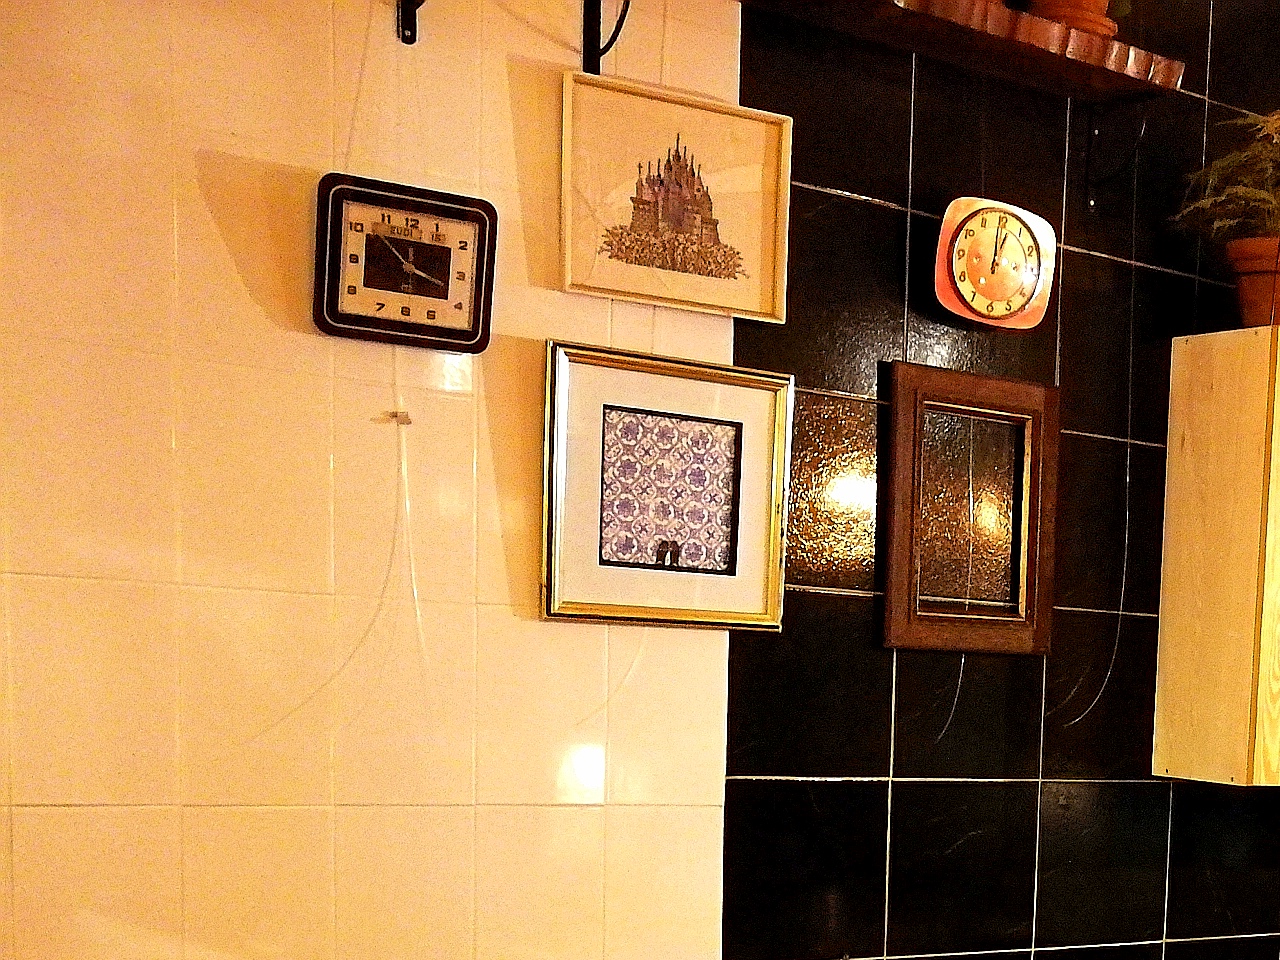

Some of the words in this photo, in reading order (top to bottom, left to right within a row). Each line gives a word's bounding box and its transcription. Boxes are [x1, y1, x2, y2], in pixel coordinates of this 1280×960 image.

[349, 222, 364, 233] 10
[405, 217, 420, 229] 12
[964, 229, 976, 239] 10
[458, 240, 468, 251] 2
[1027, 245, 1034, 257] 2
[957, 249, 966, 260] 9
[456, 271, 466, 281] 3
[958, 271, 967, 282] 8
[970, 290, 977, 302] 7
[376, 302, 386, 312] 7
[986, 302, 994, 312] 6
[1005, 300, 1013, 311] 5
